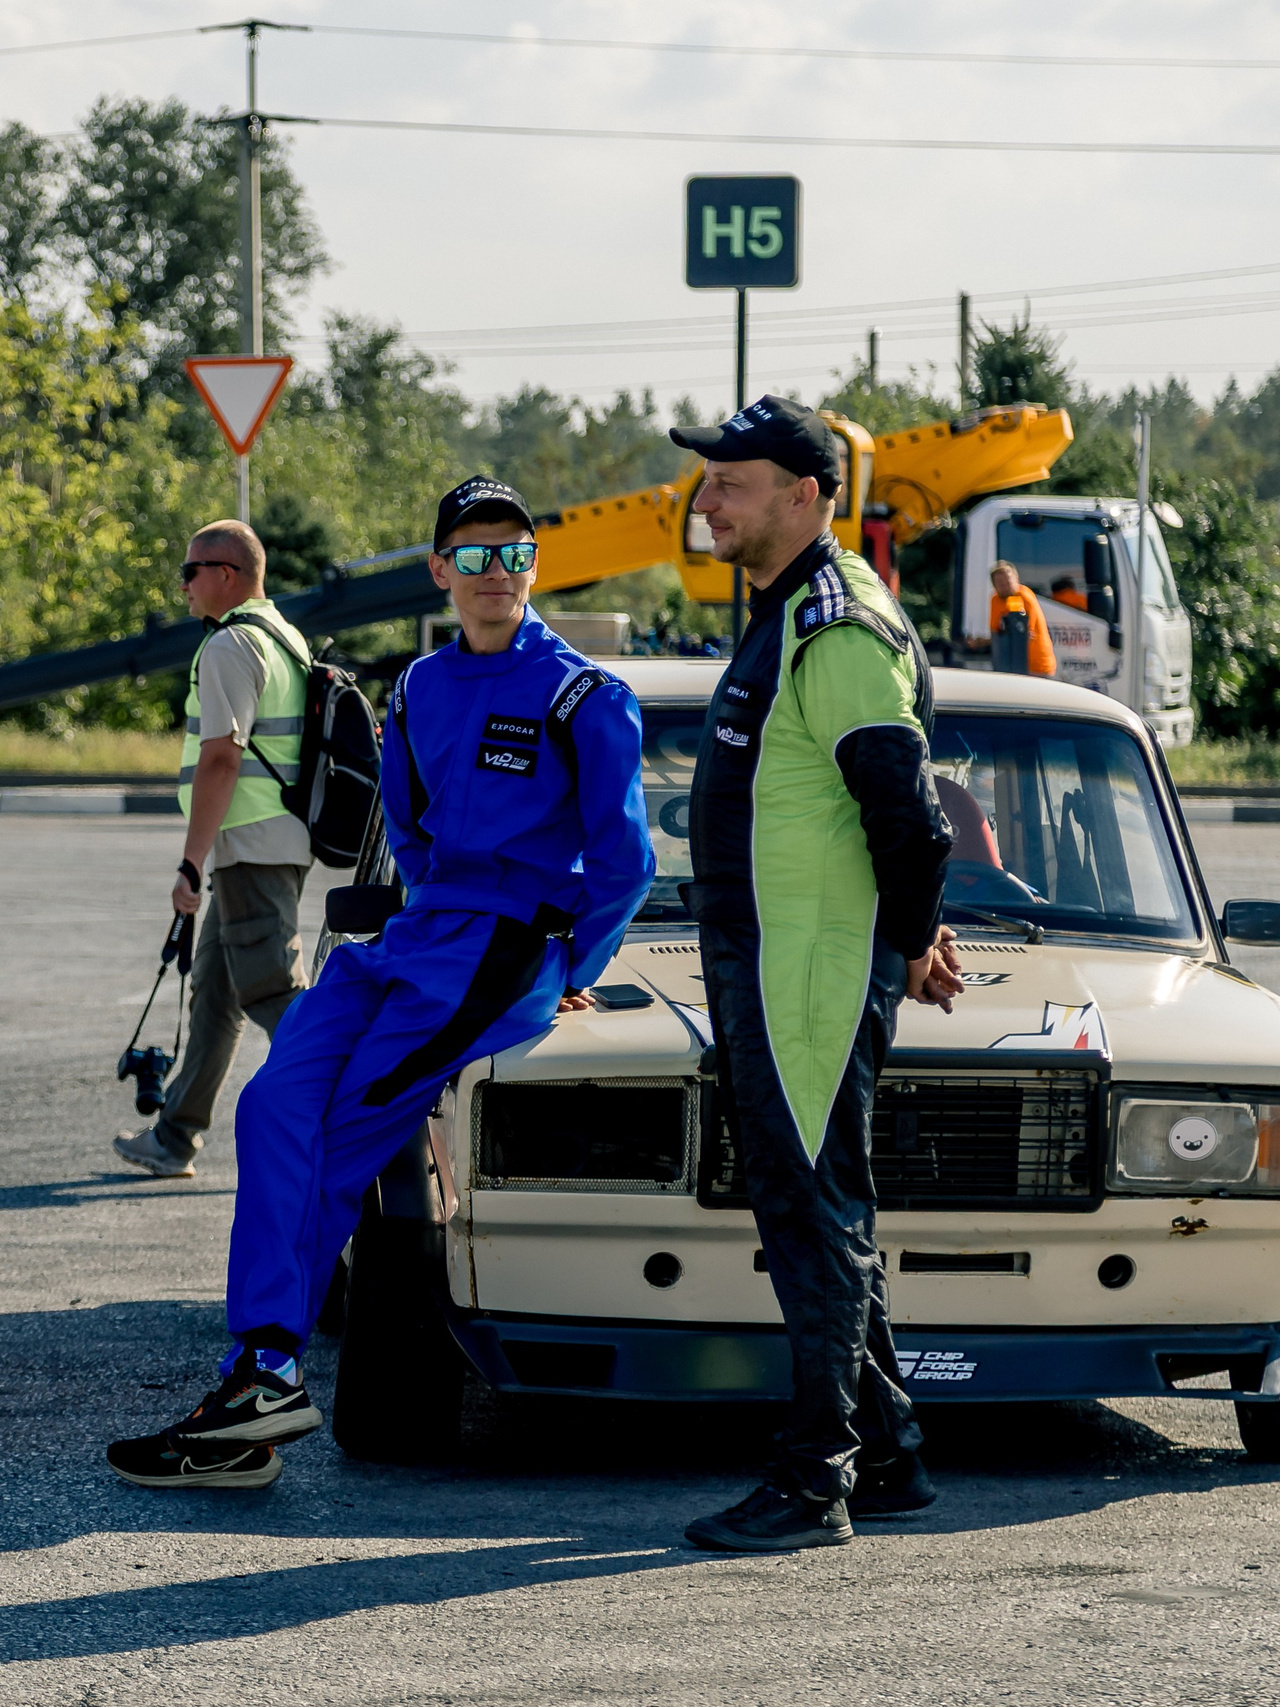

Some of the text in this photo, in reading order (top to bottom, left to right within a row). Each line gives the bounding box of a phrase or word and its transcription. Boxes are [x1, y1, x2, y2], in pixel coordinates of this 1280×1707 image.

[701, 205, 784, 259] H5
[456, 481, 512, 495] EXPOCAR
[493, 492, 513, 502] TEAM
[557, 677, 593, 721] sparco
[491, 722, 535, 736] EXPOCAR
[733, 733, 749, 743] TEAM
[512, 757, 530, 767] TEAM
[924, 1351, 964, 1361] CHIP
[918, 1361, 978, 1371] FORCE
[914, 1371, 973, 1381] GROUP
